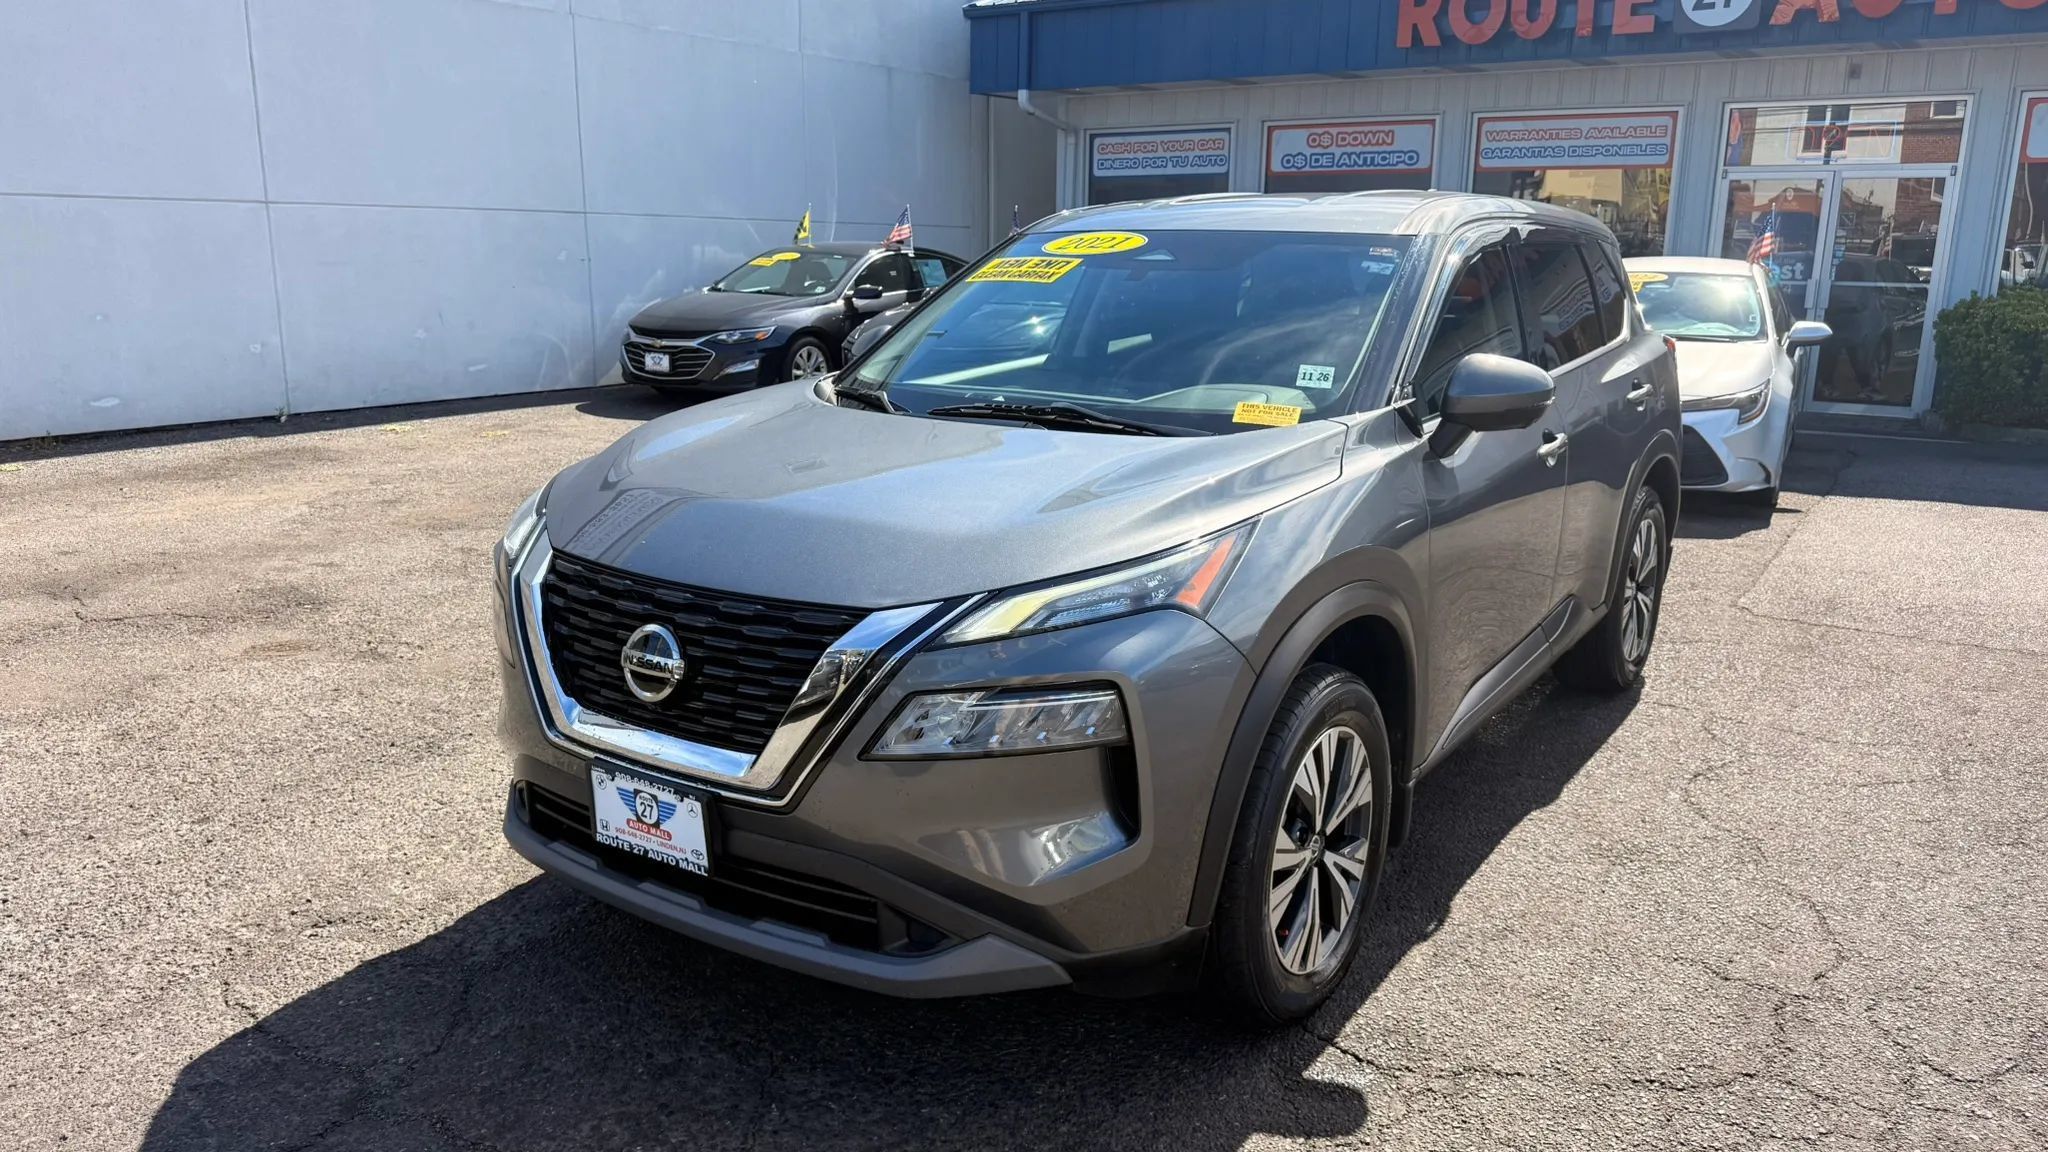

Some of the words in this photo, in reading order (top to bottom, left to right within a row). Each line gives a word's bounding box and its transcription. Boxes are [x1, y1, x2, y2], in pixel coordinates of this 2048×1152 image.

[1336, 129, 1395, 147] DOWN
[1486, 128, 1582, 143] WARRANTIES
[1585, 125, 1669, 139] AVAILABLE
[1098, 142, 1131, 154] CASH
[1133, 141, 1158, 153] FOR
[1159, 140, 1195, 152] YOUR
[1195, 139, 1225, 151] CAR
[1481, 145, 1566, 159] GARANTIAS
[1567, 143, 1669, 158] DISPONIBLES
[1097, 158, 1140, 170] DINERO
[1141, 157, 1168, 169] POR
[1170, 156, 1189, 168] TU
[1190, 154, 1227, 167] AUTO
[1309, 152, 1336, 169] DE
[1336, 150, 1420, 169] ANTICIPO
[1052, 237, 1134, 250] 2021
[971, 270, 1010, 280] CLEAN
[1006, 270, 1055, 280] CARFAX
[1301, 372, 1313, 381] 11
[1316, 372, 1330, 382] 26
[1262, 405, 1298, 413] VEHICLE
[624, 651, 674, 675] NISSAN
[639, 802, 654, 820] 27
[629, 820, 648, 832] AUTO
[650, 826, 670, 840] MALL
[596, 833, 630, 851] ROUTE
[632, 844, 645, 856] 27
[648, 849, 677, 866] AUTO
[679, 859, 708, 877] MALL
